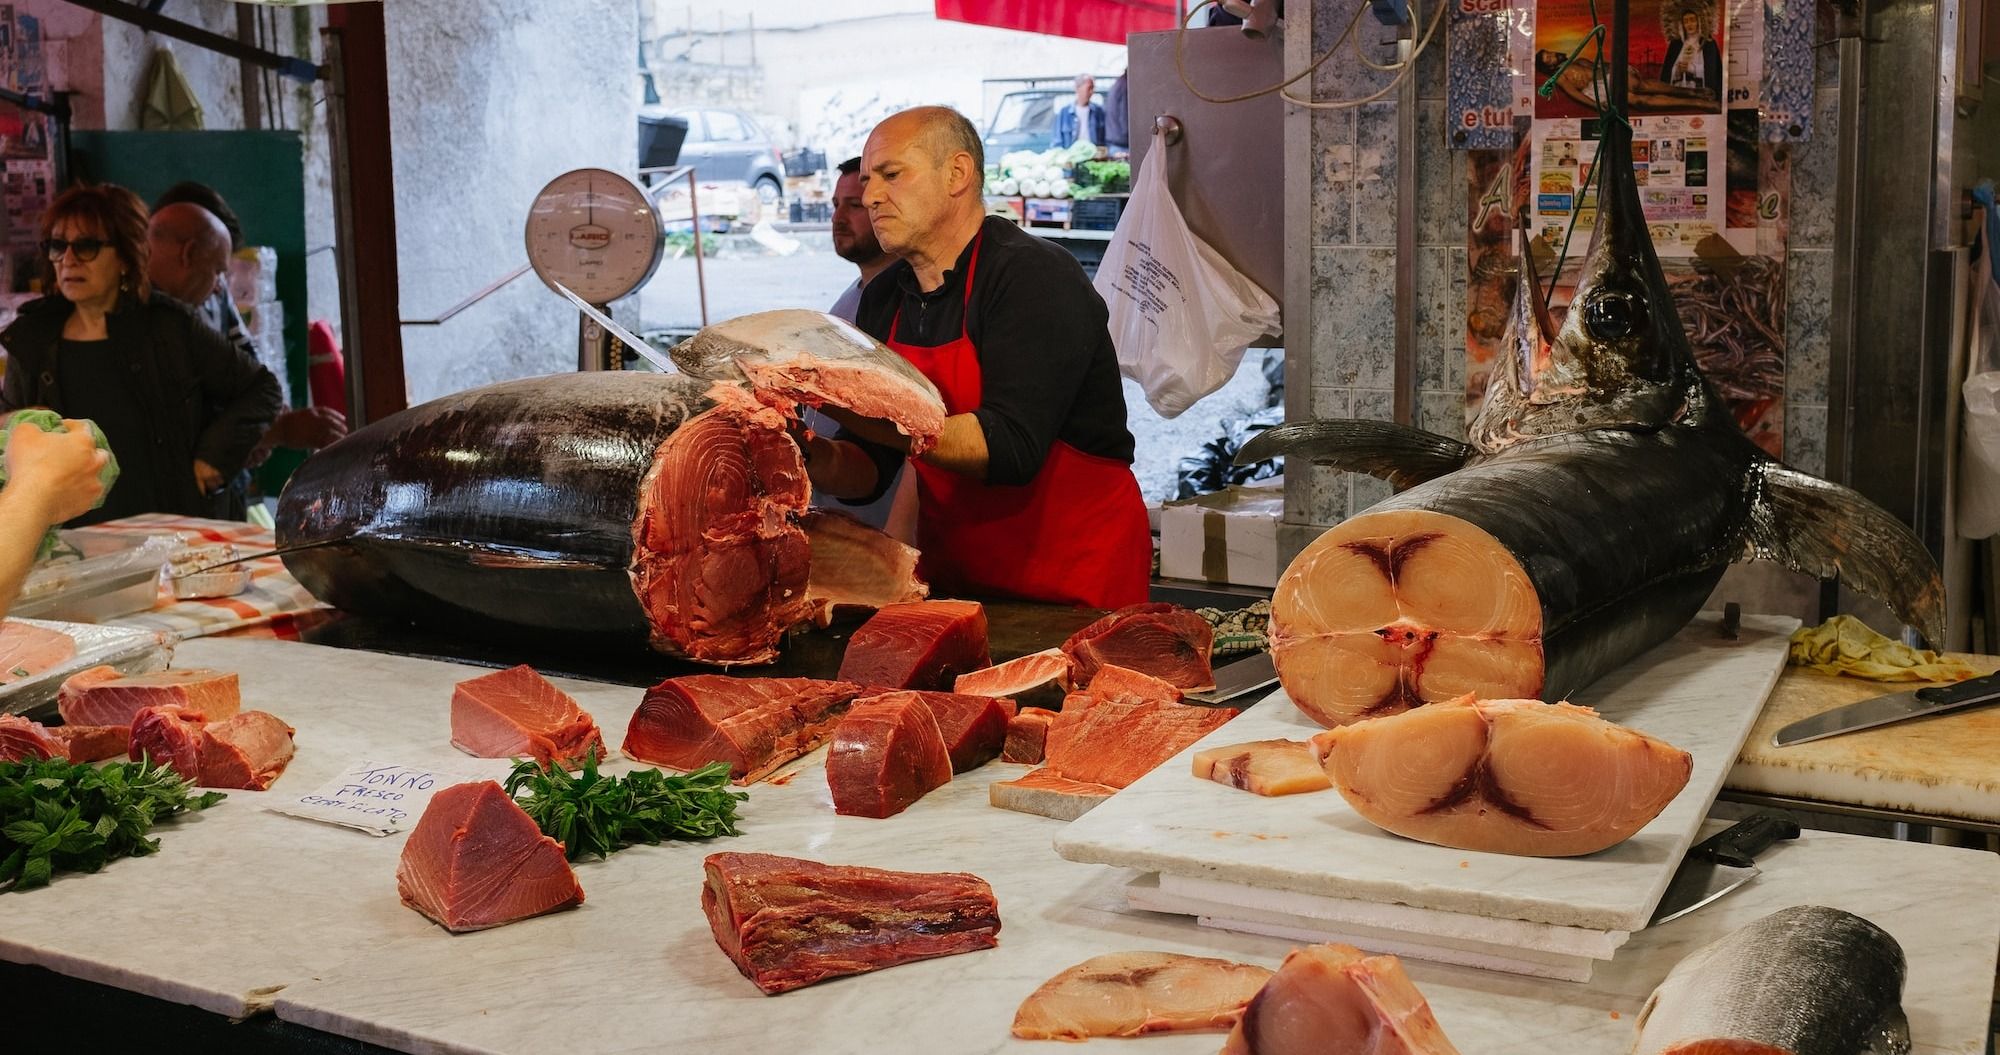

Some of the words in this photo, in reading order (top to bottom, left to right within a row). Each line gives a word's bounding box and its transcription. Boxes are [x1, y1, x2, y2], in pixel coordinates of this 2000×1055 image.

[1464, 112, 1477, 127] e
[350, 765, 435, 790] TONNO
[335, 784, 405, 801] FRESCO
